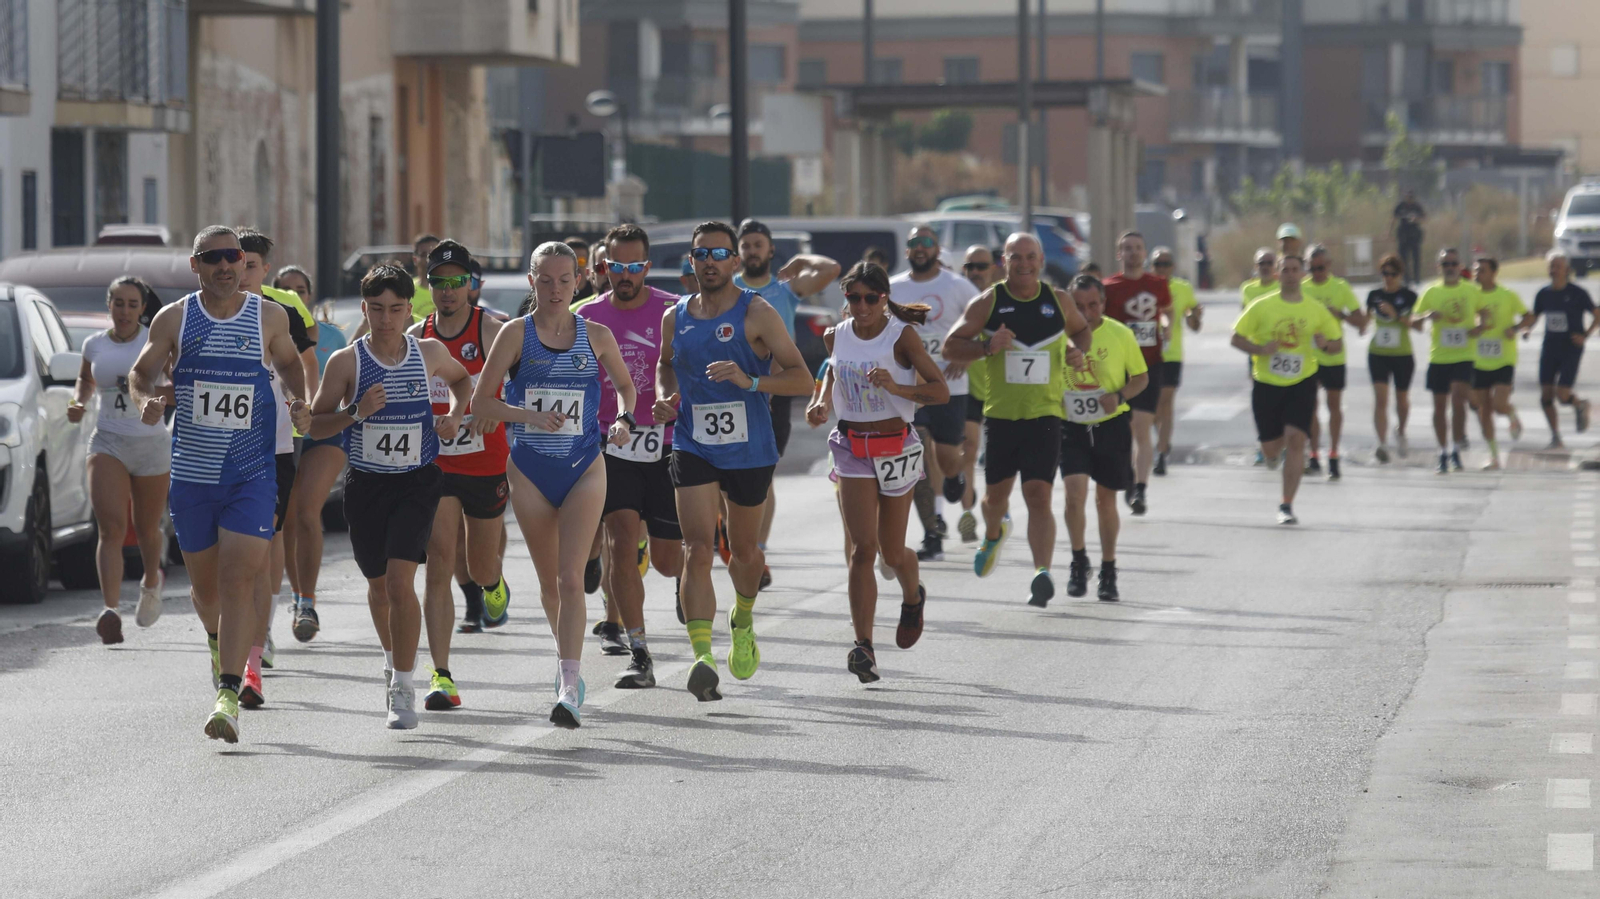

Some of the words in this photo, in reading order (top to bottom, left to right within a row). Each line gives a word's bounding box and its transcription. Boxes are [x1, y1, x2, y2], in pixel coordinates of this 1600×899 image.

[1022, 358, 1035, 377] 7
[1272, 356, 1301, 374] 263
[114, 393, 127, 412] 4
[199, 391, 249, 420] 146
[1074, 397, 1099, 416] 39
[704, 411, 735, 436] 33
[376, 433, 410, 457] 44
[881, 451, 922, 482] 277
